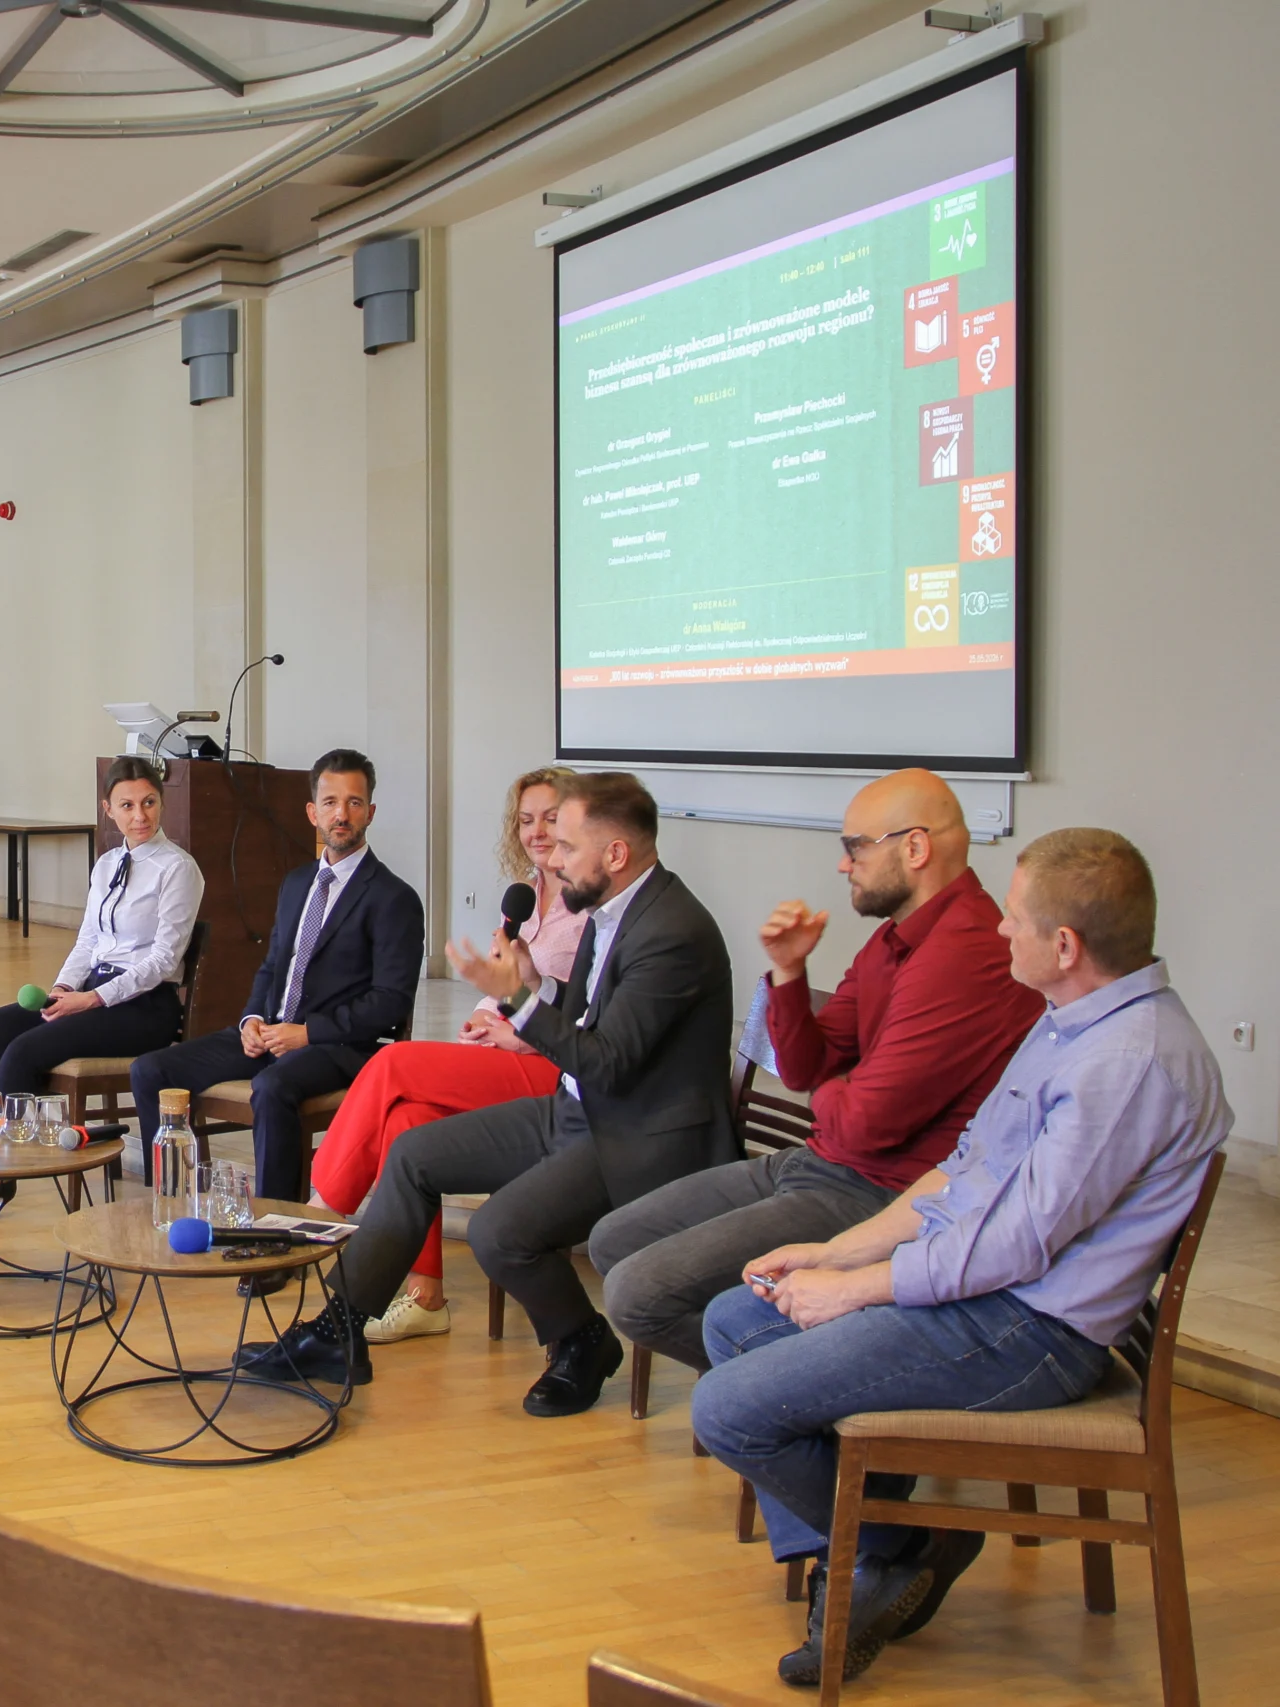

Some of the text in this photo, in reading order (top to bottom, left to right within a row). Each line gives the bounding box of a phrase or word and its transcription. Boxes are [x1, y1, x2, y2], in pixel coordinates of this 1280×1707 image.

[933, 203, 941, 222] 3
[840, 245, 870, 264] sala 111
[780, 269, 798, 283] 11:40
[806, 261, 824, 276] 12:40
[908, 292, 915, 311] 4
[588, 285, 870, 383] Przedsiębiorczość społeczna i zrównoważone modele
[962, 319, 969, 338] 5
[585, 379, 619, 400] biznesu
[655, 363, 671, 380] dla
[673, 337, 766, 376] zrównoważonego
[768, 322, 816, 349] rozwoju
[818, 304, 875, 335] regionu?
[693, 386, 736, 406] PANELIŚCI
[803, 392, 846, 414] Piechocki
[923, 409, 931, 429] 8
[607, 440, 616, 453] dr
[772, 457, 782, 470] dr
[782, 454, 800, 467] Ewa
[583, 496, 591, 507] dr
[591, 493, 604, 505] hab.
[684, 473, 700, 487] UEP
[962, 485, 969, 504] 9
[693, 598, 737, 611] MODERACJA
[683, 623, 692, 635] dr
[692, 621, 712, 634] Anna
[745, 665, 752, 674] w
[753, 662, 772, 675] dobie
[774, 660, 813, 676] globalnych
